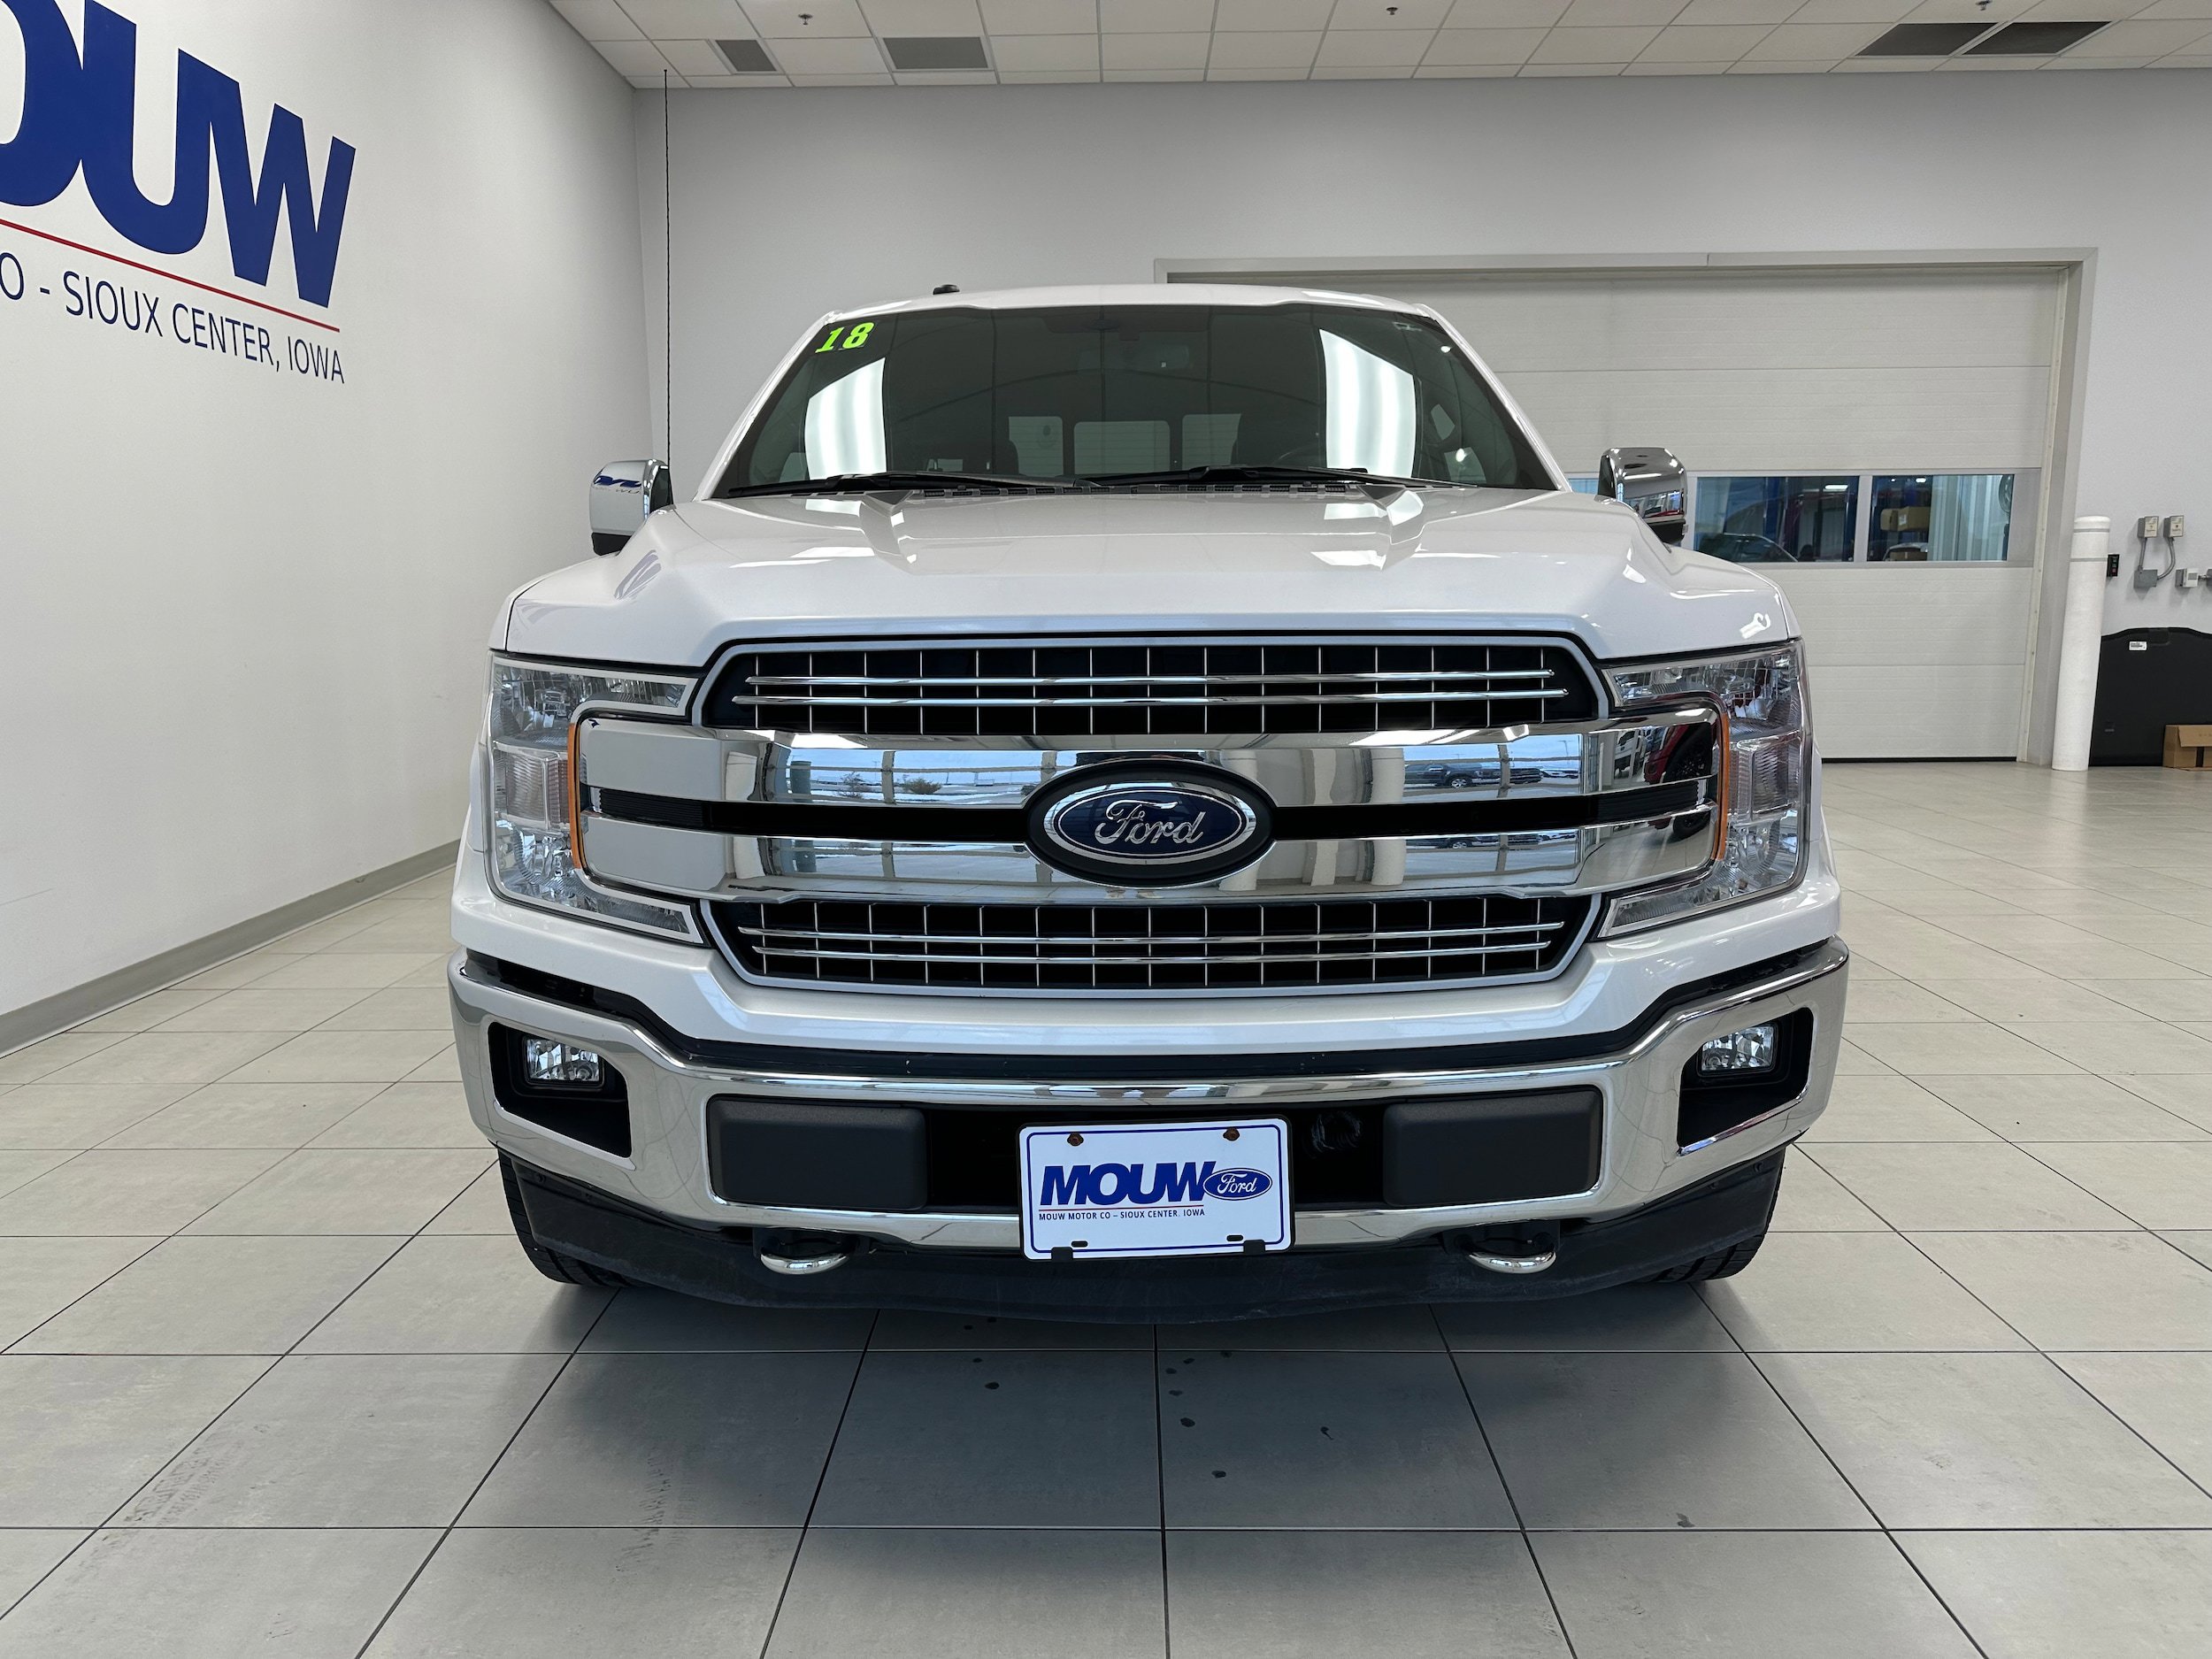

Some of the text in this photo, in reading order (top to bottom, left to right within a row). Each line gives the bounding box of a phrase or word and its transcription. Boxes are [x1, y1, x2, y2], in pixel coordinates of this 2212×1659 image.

[63, 270, 164, 337] SIOUX
[172, 303, 280, 373] CENTER,
[287, 335, 345, 384] IOWA
[814, 321, 875, 354] 18
[1094, 799, 1206, 845] Ford
[1040, 1161, 1217, 1206] MOUW
[1217, 1172, 1258, 1194] Ford
